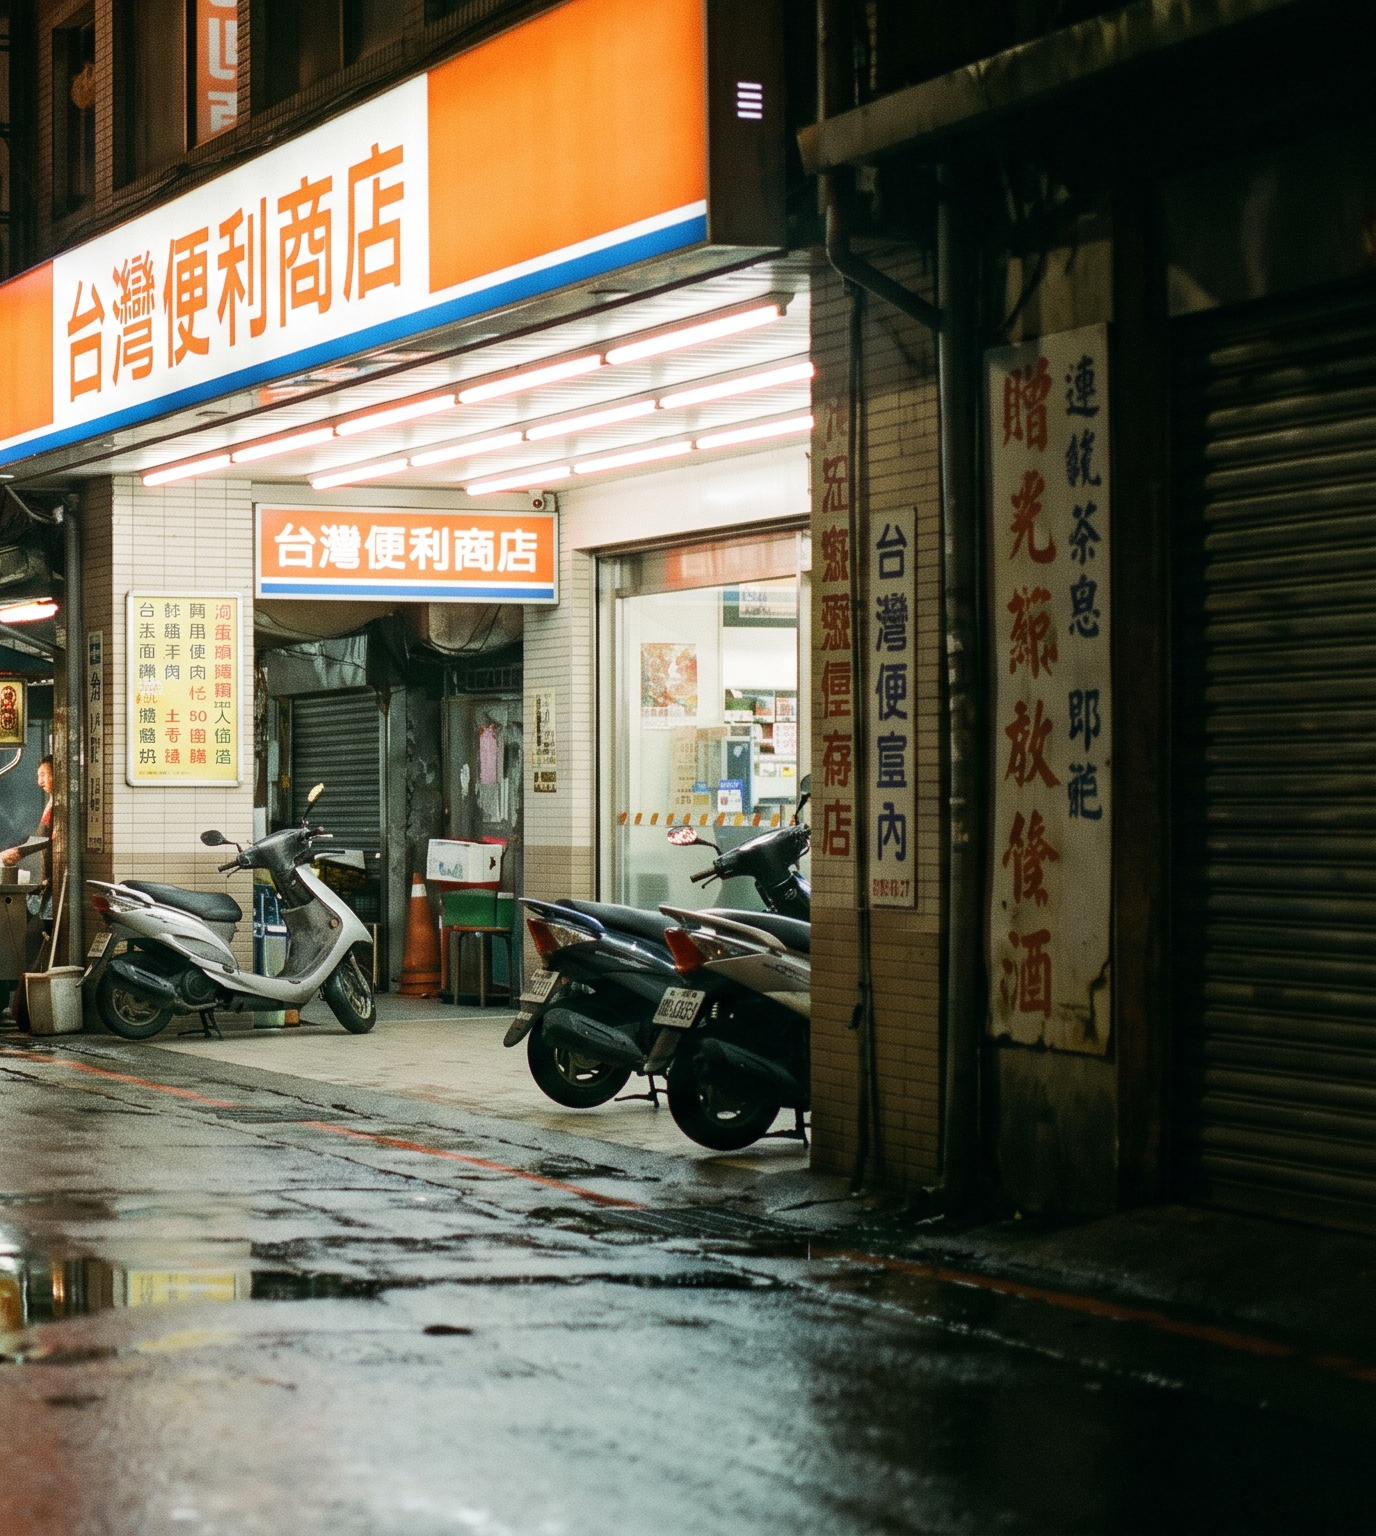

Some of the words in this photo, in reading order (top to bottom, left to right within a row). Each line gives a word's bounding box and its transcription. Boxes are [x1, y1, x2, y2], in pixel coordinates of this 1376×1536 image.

[66, 142, 405, 403] 台灣便利商店
[273, 522, 538, 574] 台灣便利商店
